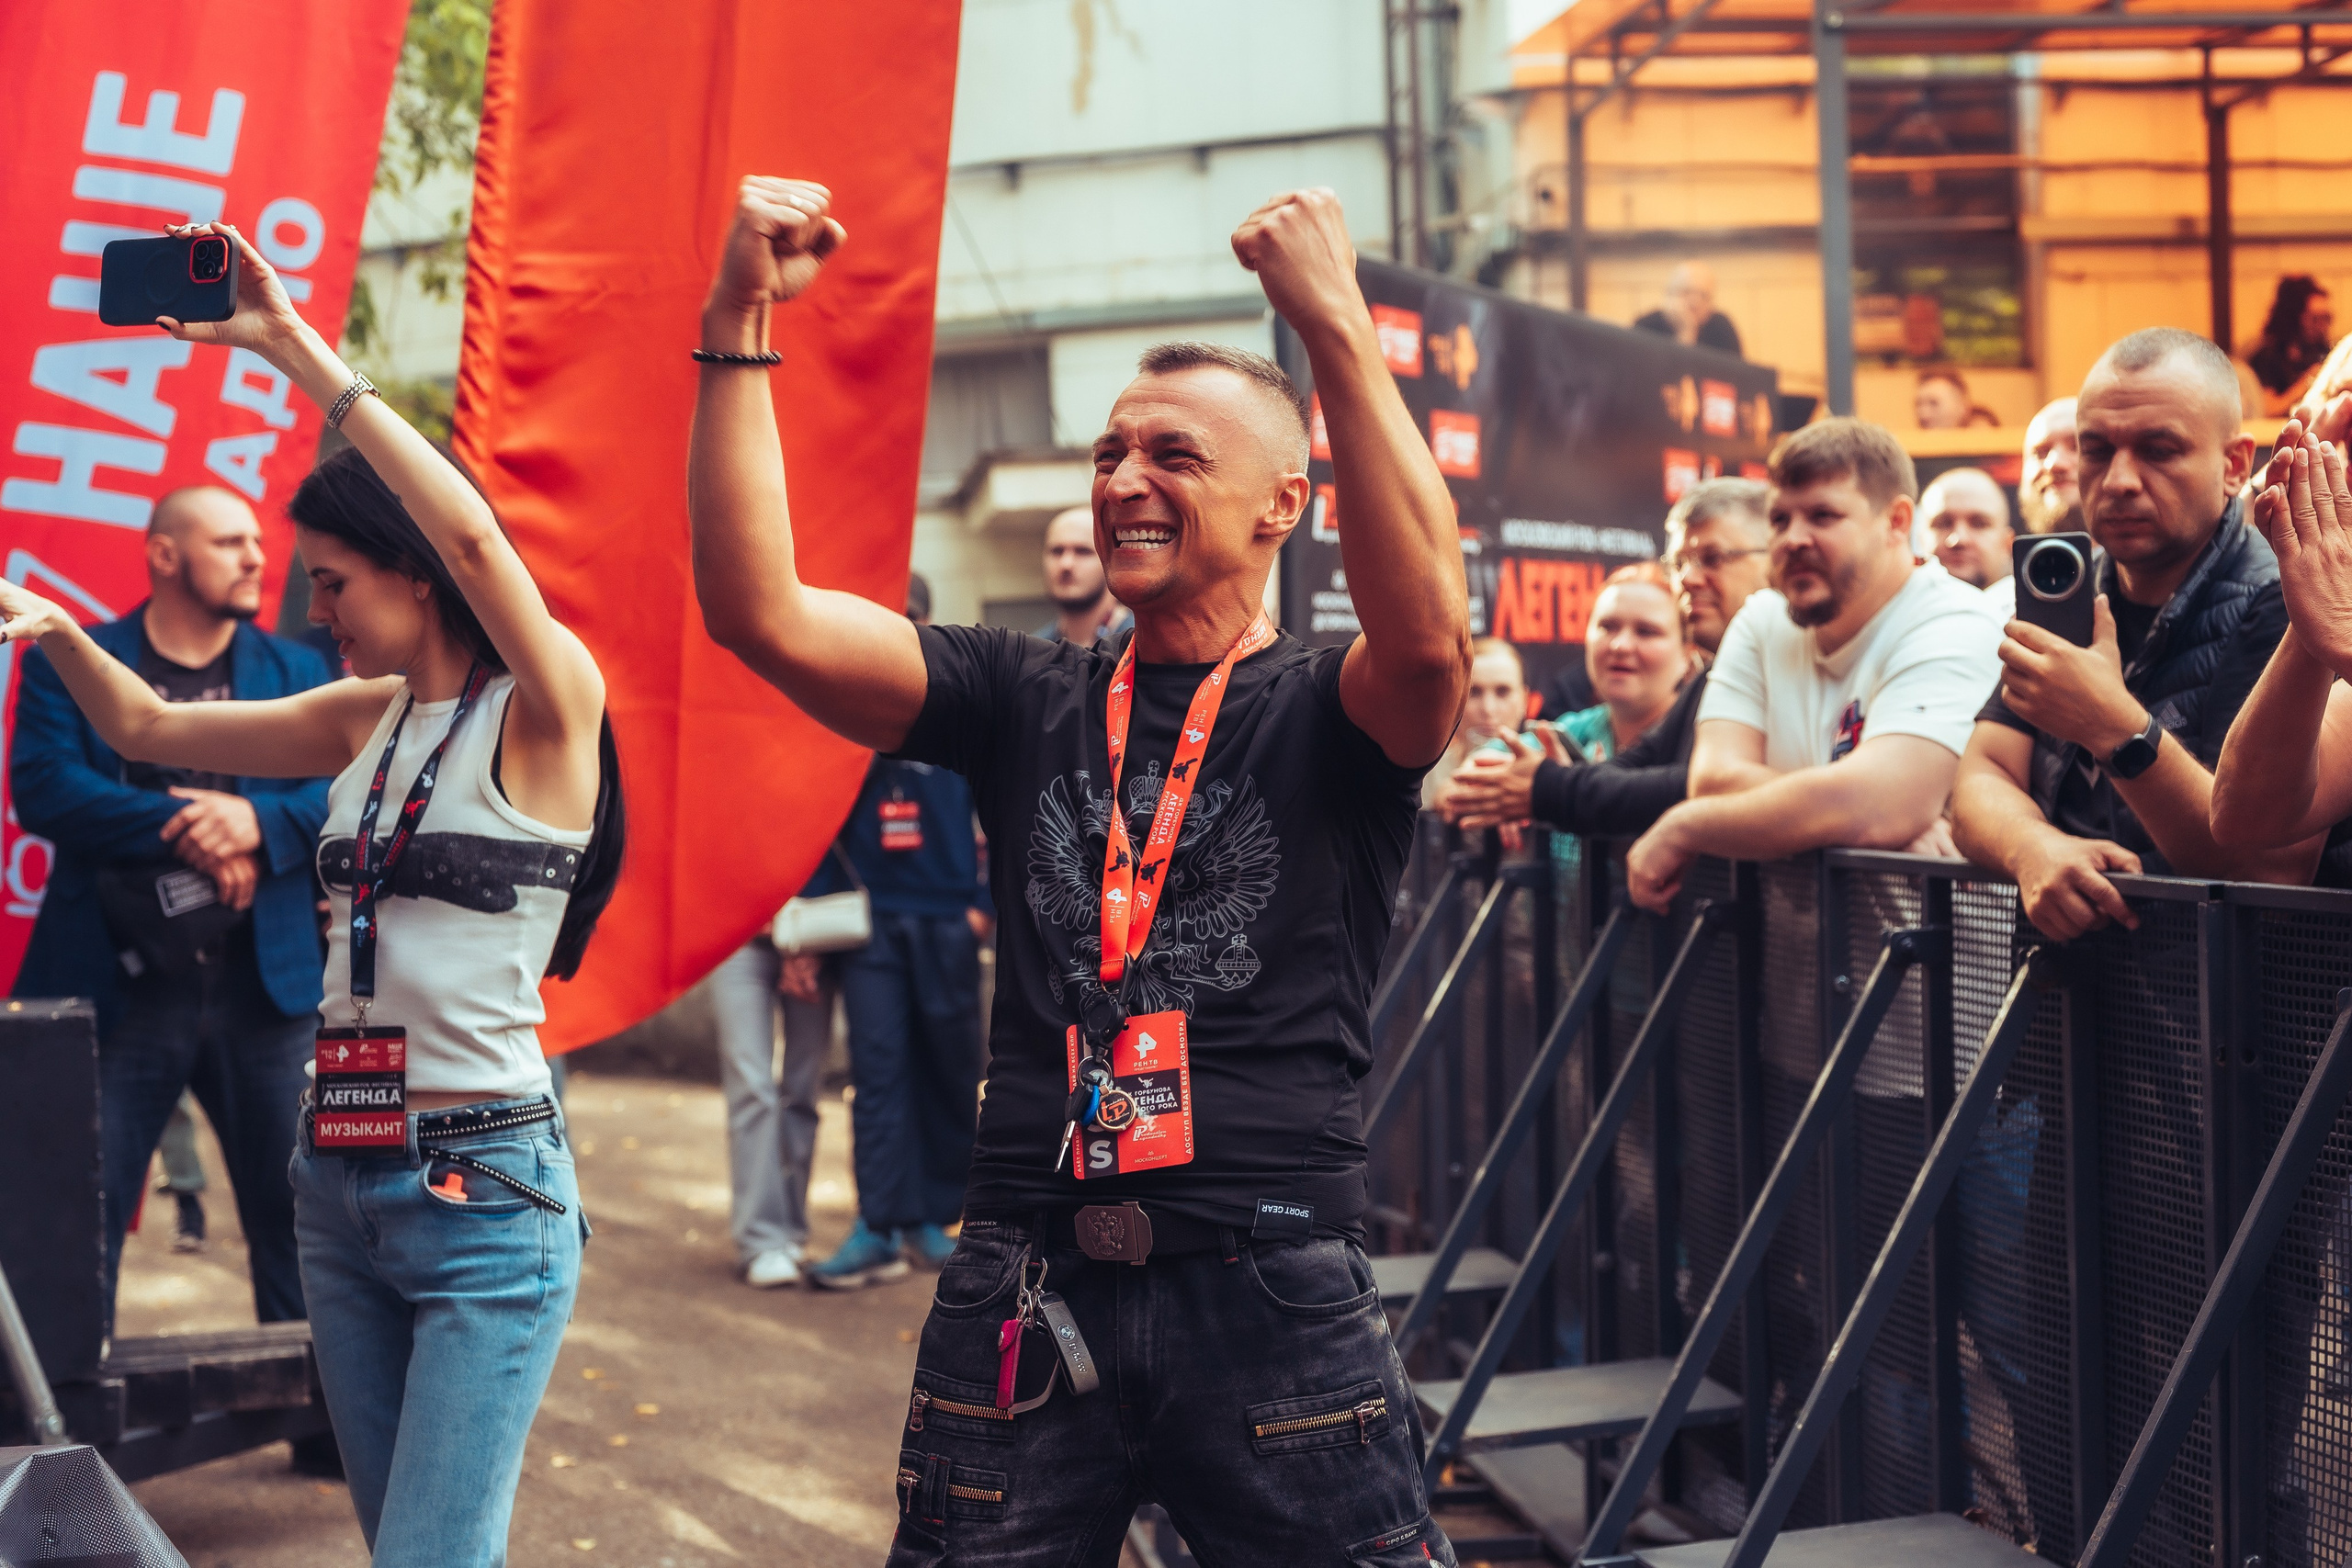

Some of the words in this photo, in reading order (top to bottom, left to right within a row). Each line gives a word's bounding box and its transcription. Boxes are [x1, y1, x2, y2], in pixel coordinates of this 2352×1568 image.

[1198, 709, 1207, 724] РЕН
[1156, 791, 1170, 825] РУССКОГО
[1156, 793, 1179, 845] ЛЕГЕНДА
[1148, 827, 1159, 845] РОКА
[1115, 909, 1122, 918] ТВ
[1178, 1021, 1187, 1066] ДОСМОТРА
[322, 1089, 402, 1106] ЛЕГЕНДА
[1134, 1091, 1175, 1106] ГЕНДА
[1135, 1086, 1171, 1096] ГОРБУНОВА
[1158, 1101, 1178, 1111] РОКА
[321, 1121, 402, 1137] МУЗЫКАНТ
[1183, 1119, 1192, 1155] ДОСТУП
[1134, 1154, 1168, 1164] МОСКОНЦЕРТ
[1261, 1204, 1283, 1213] GEAR
[1284, 1206, 1309, 1218] SPORT
